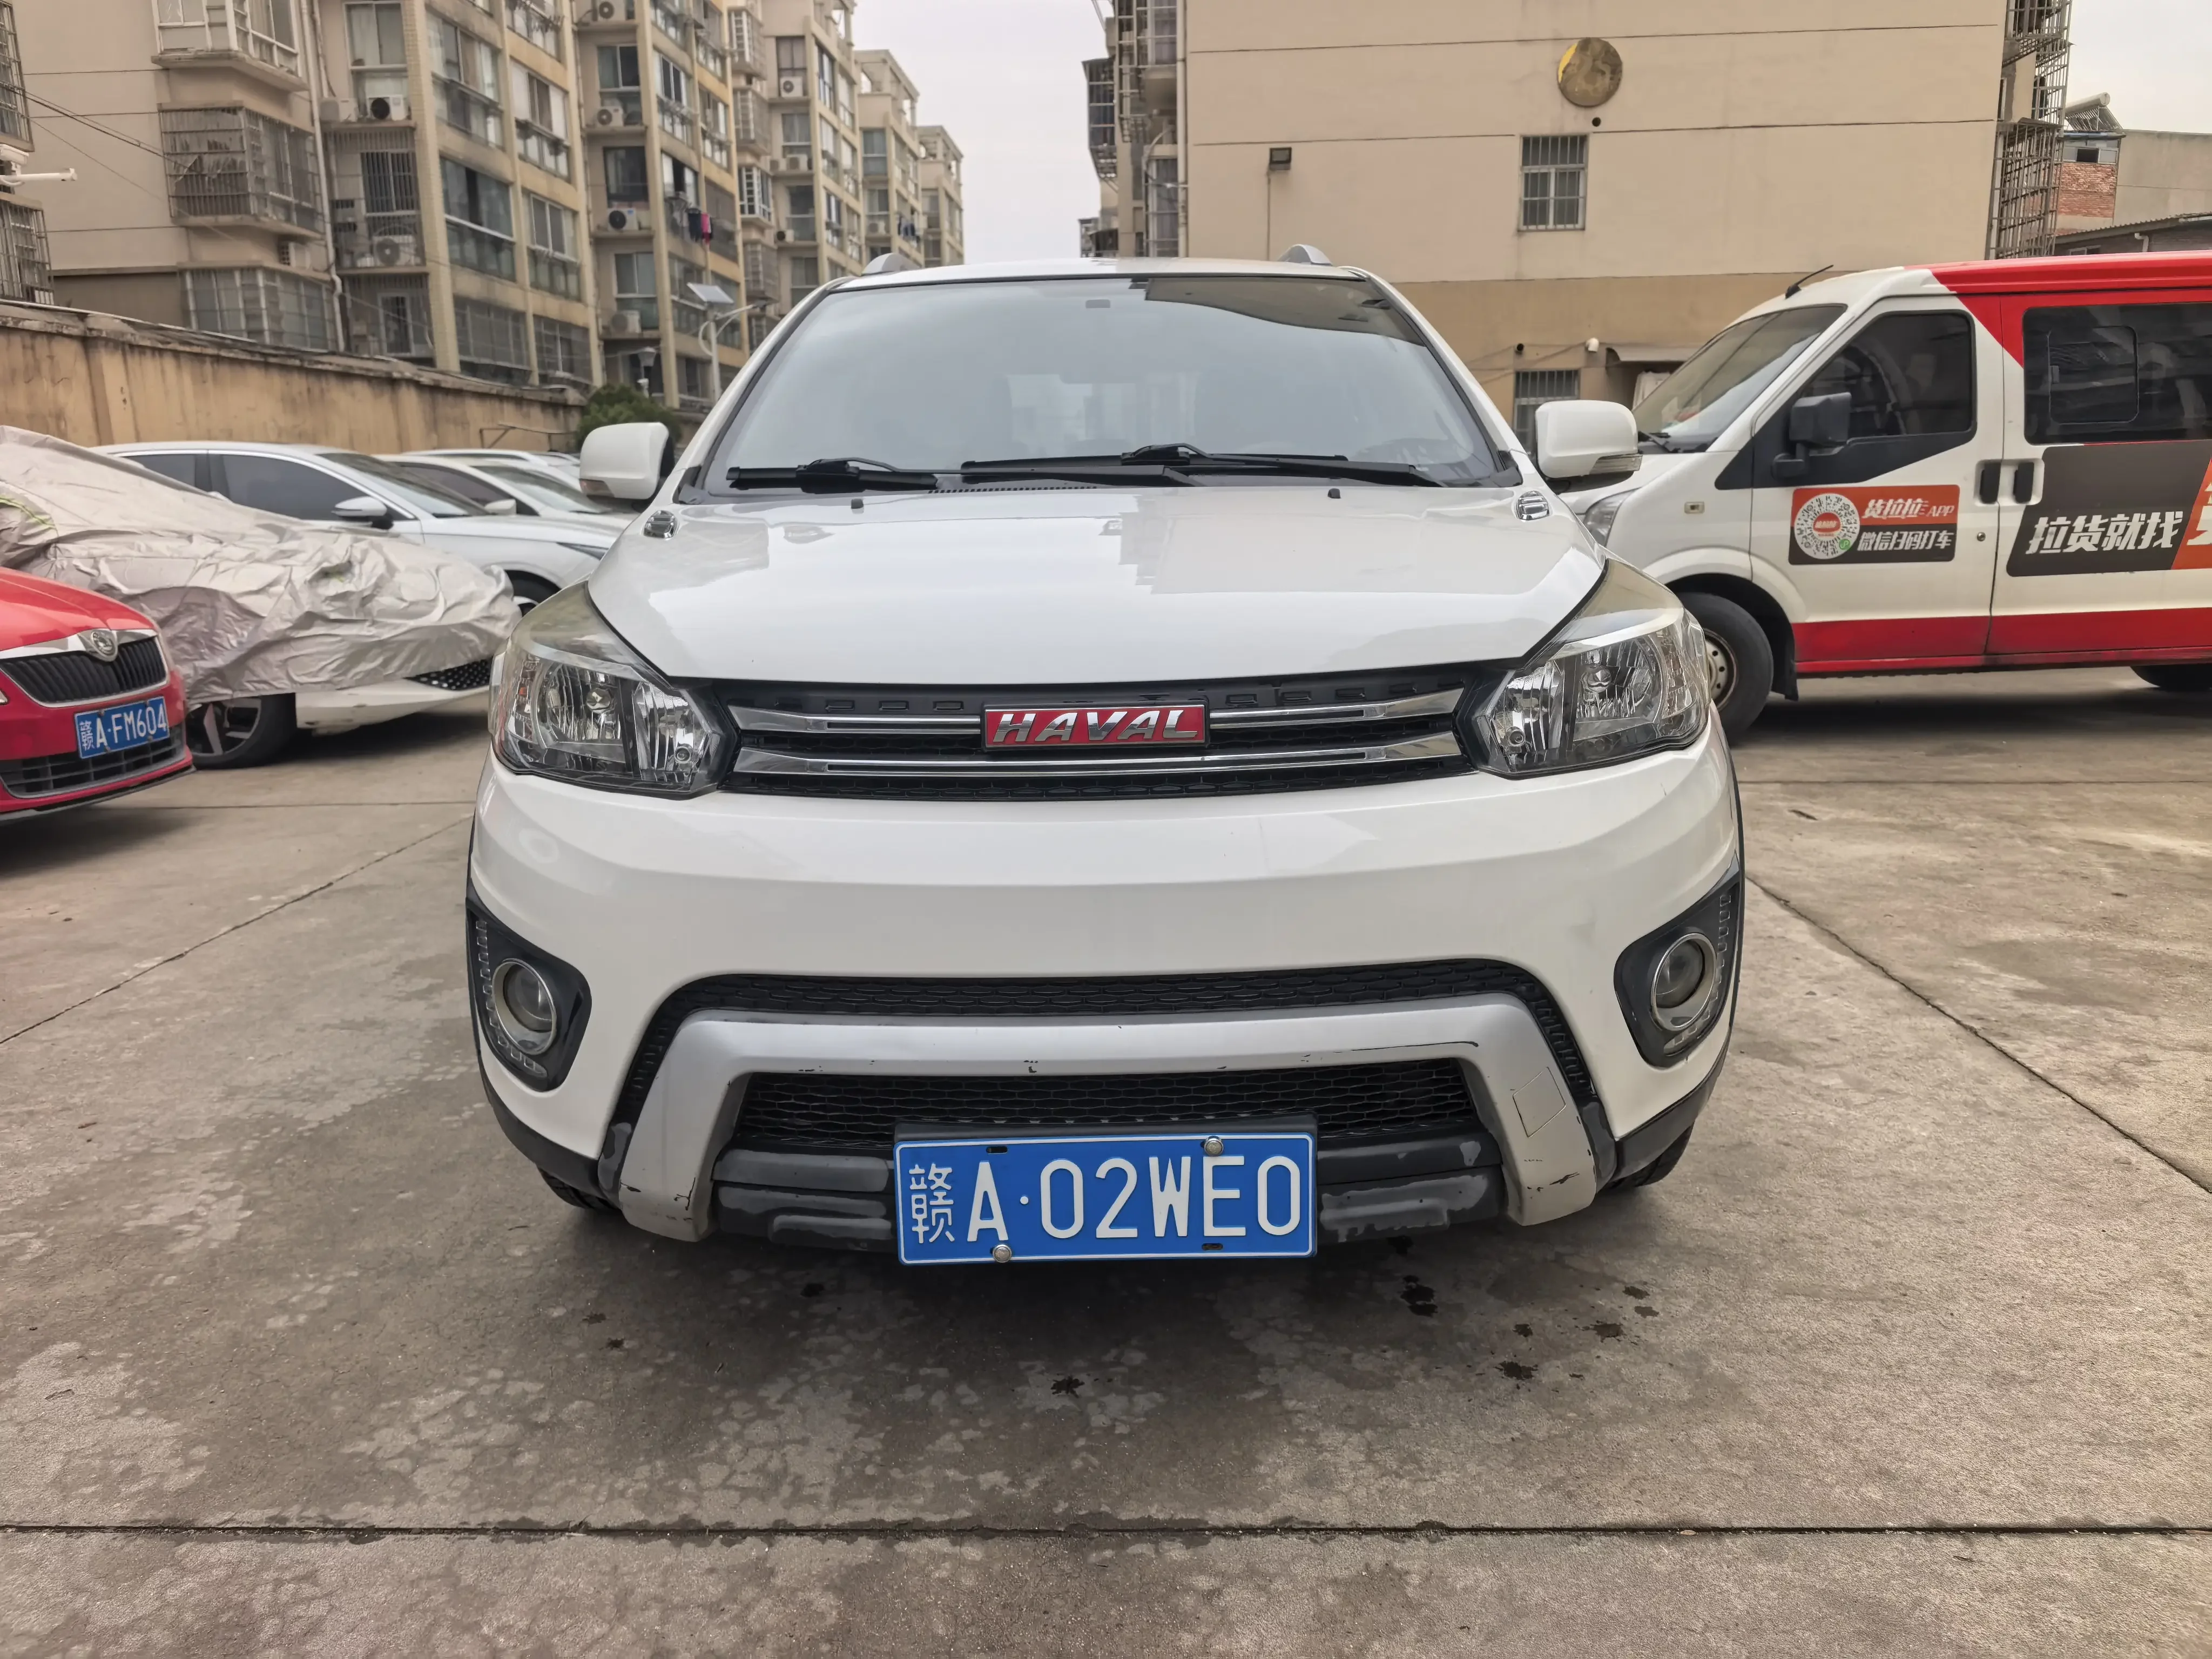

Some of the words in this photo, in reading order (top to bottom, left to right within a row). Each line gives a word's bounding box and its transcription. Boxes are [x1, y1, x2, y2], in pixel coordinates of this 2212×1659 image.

[1862, 498, 1925, 520] 货拉拉
[1926, 505, 1954, 517] APP
[1858, 530, 1954, 551] 微信扫码打车
[2025, 511, 2183, 554] 拉货就找
[993, 710, 1198, 743] HAVAL
